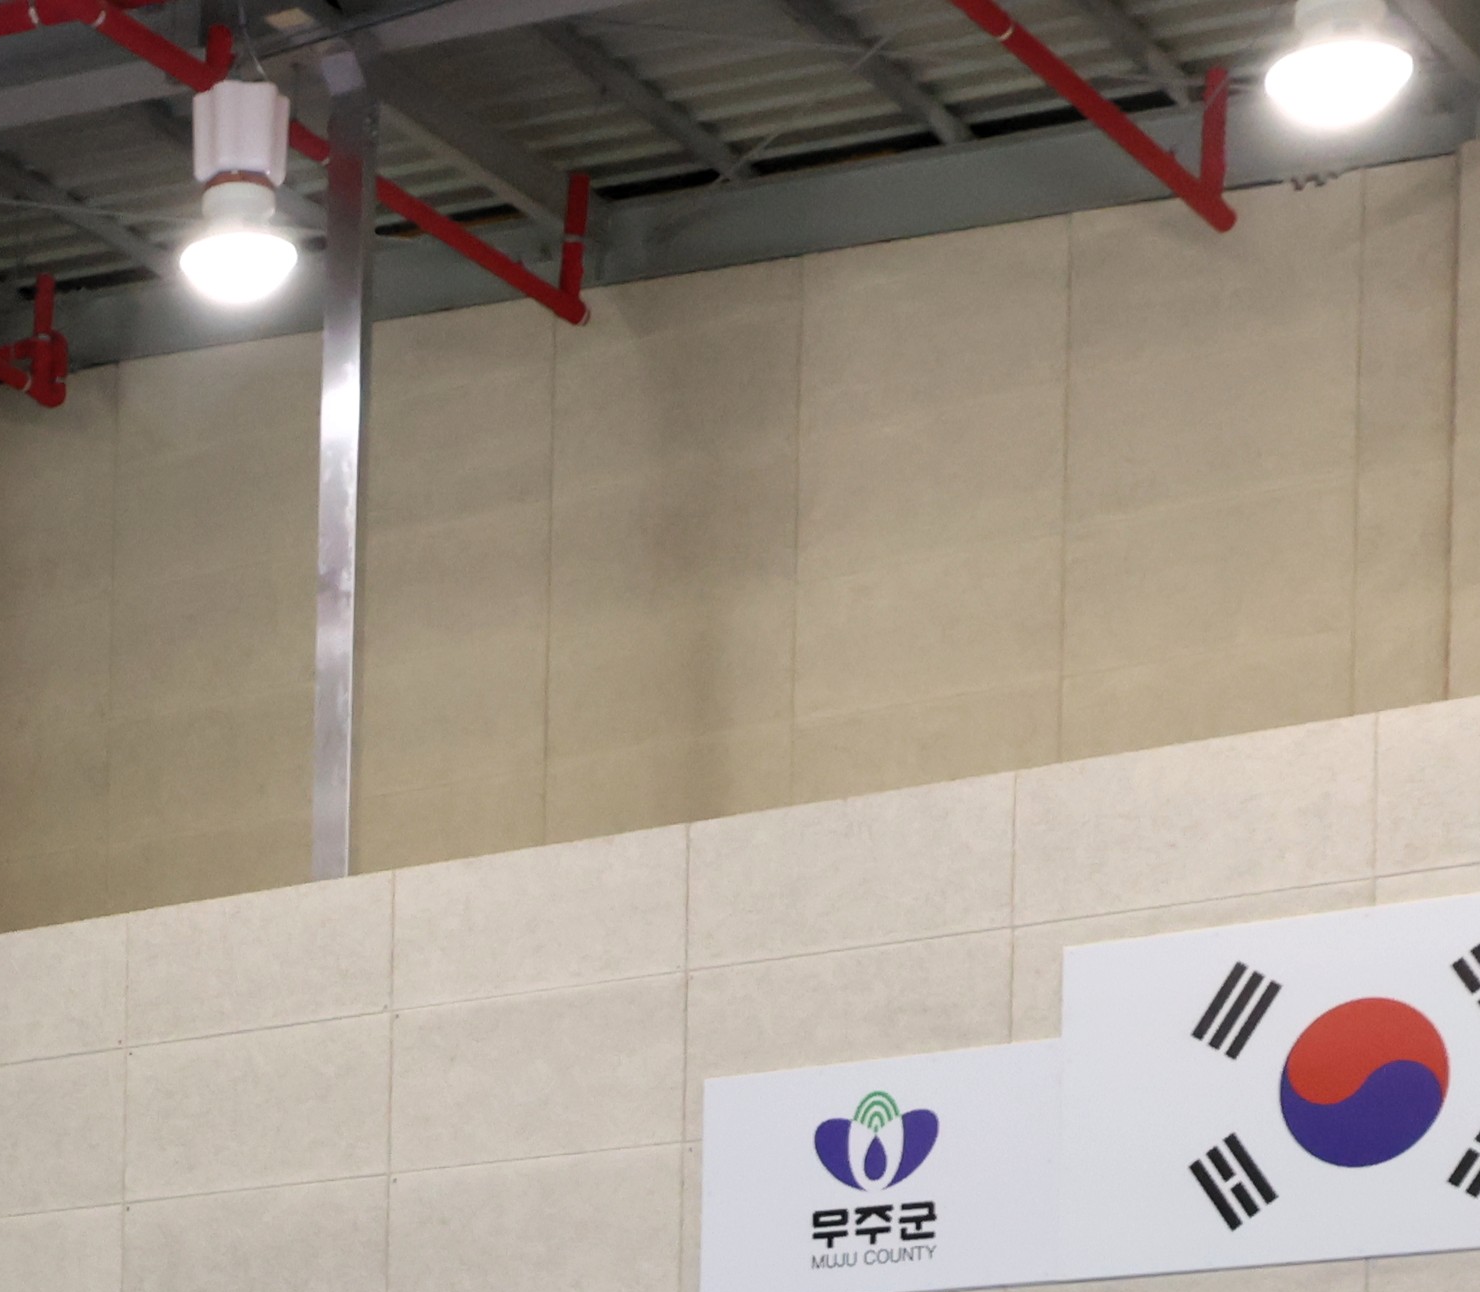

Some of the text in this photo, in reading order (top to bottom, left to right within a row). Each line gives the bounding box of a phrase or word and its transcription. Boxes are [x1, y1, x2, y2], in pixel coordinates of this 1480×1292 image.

[812, 1201, 937, 1249] 무주군
[811, 1245, 937, 1270] MUJU COUNTY
